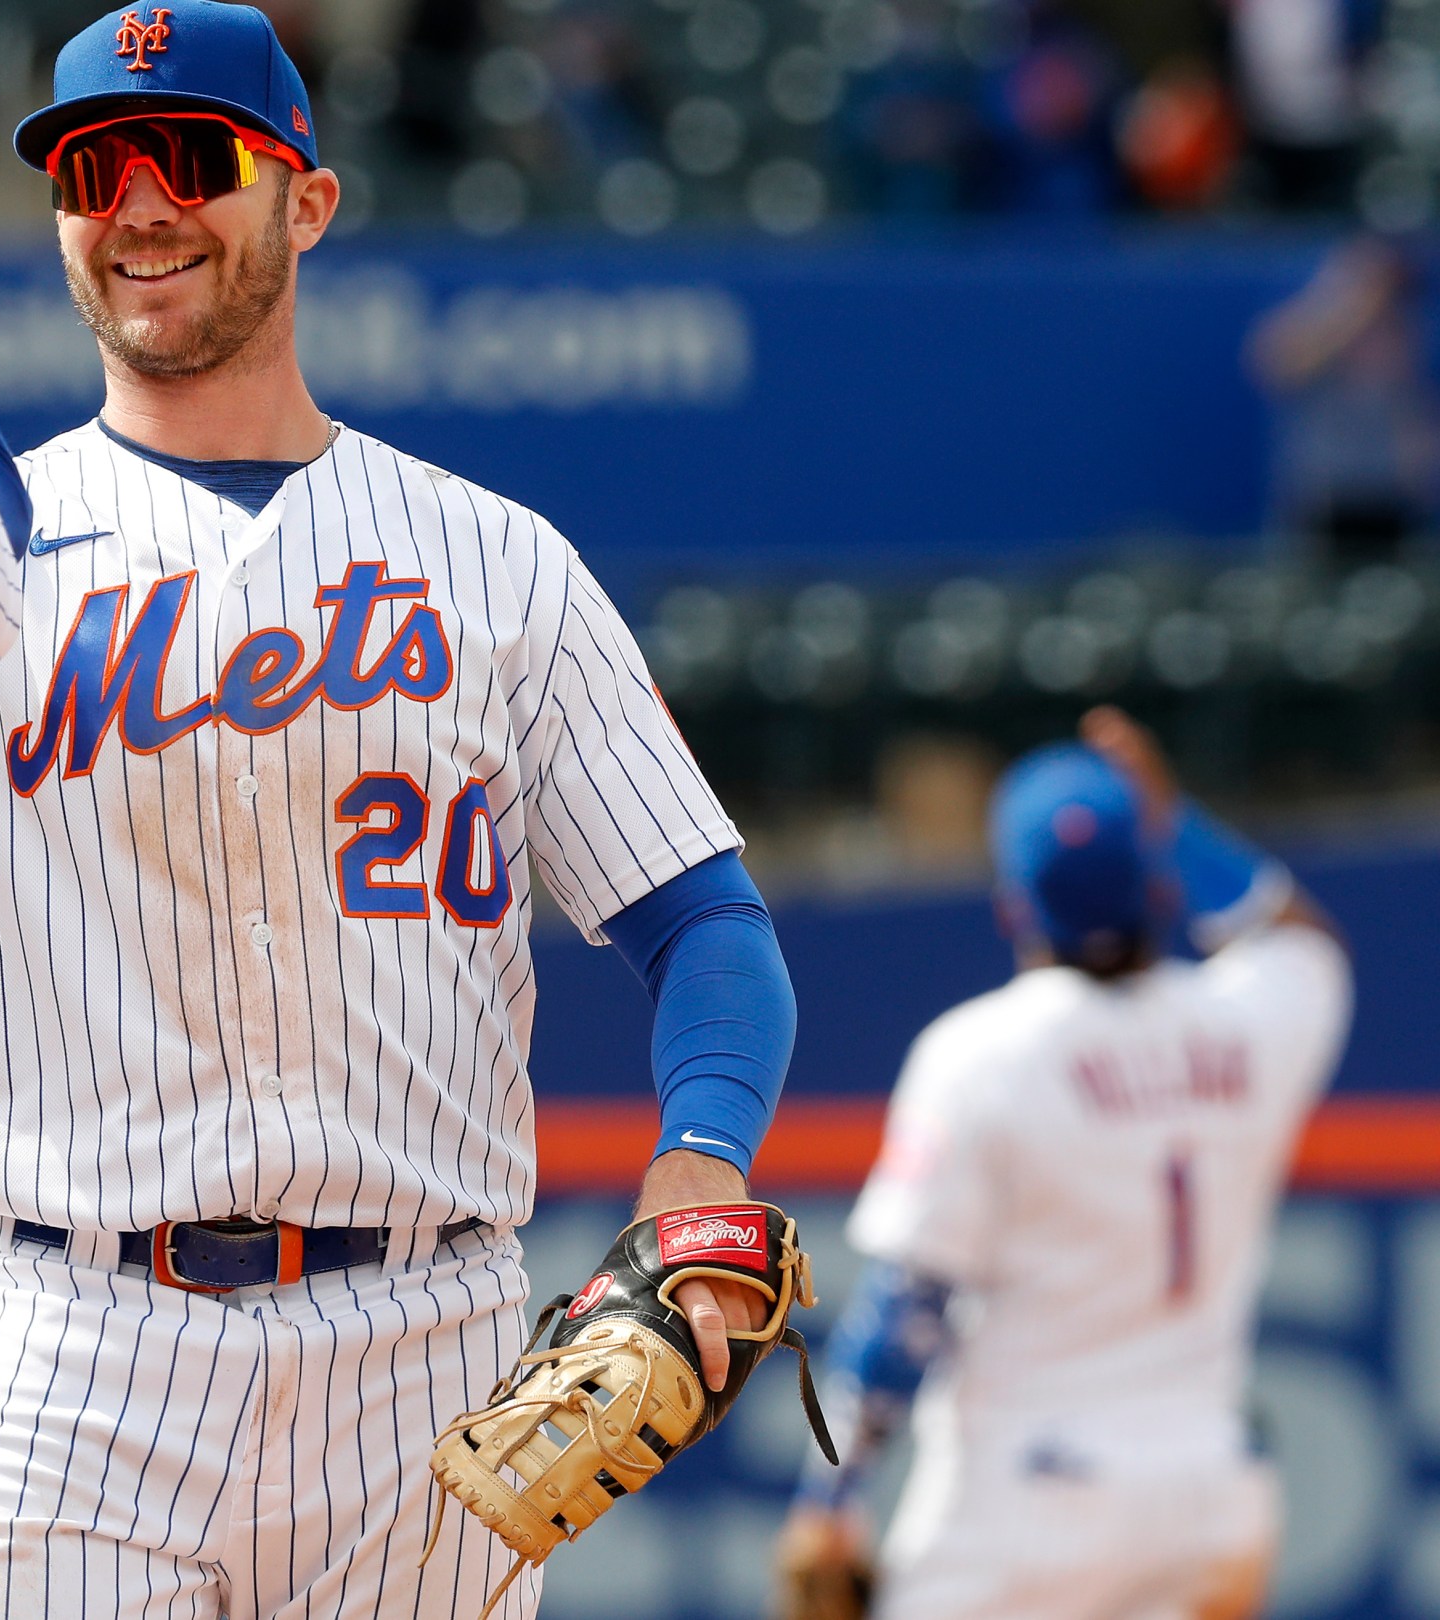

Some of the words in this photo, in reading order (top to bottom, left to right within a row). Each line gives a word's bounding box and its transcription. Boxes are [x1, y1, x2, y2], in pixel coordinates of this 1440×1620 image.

[7, 560, 453, 798] Mets
[334, 770, 513, 928] 20
[669, 1222, 758, 1247] Rawlings
